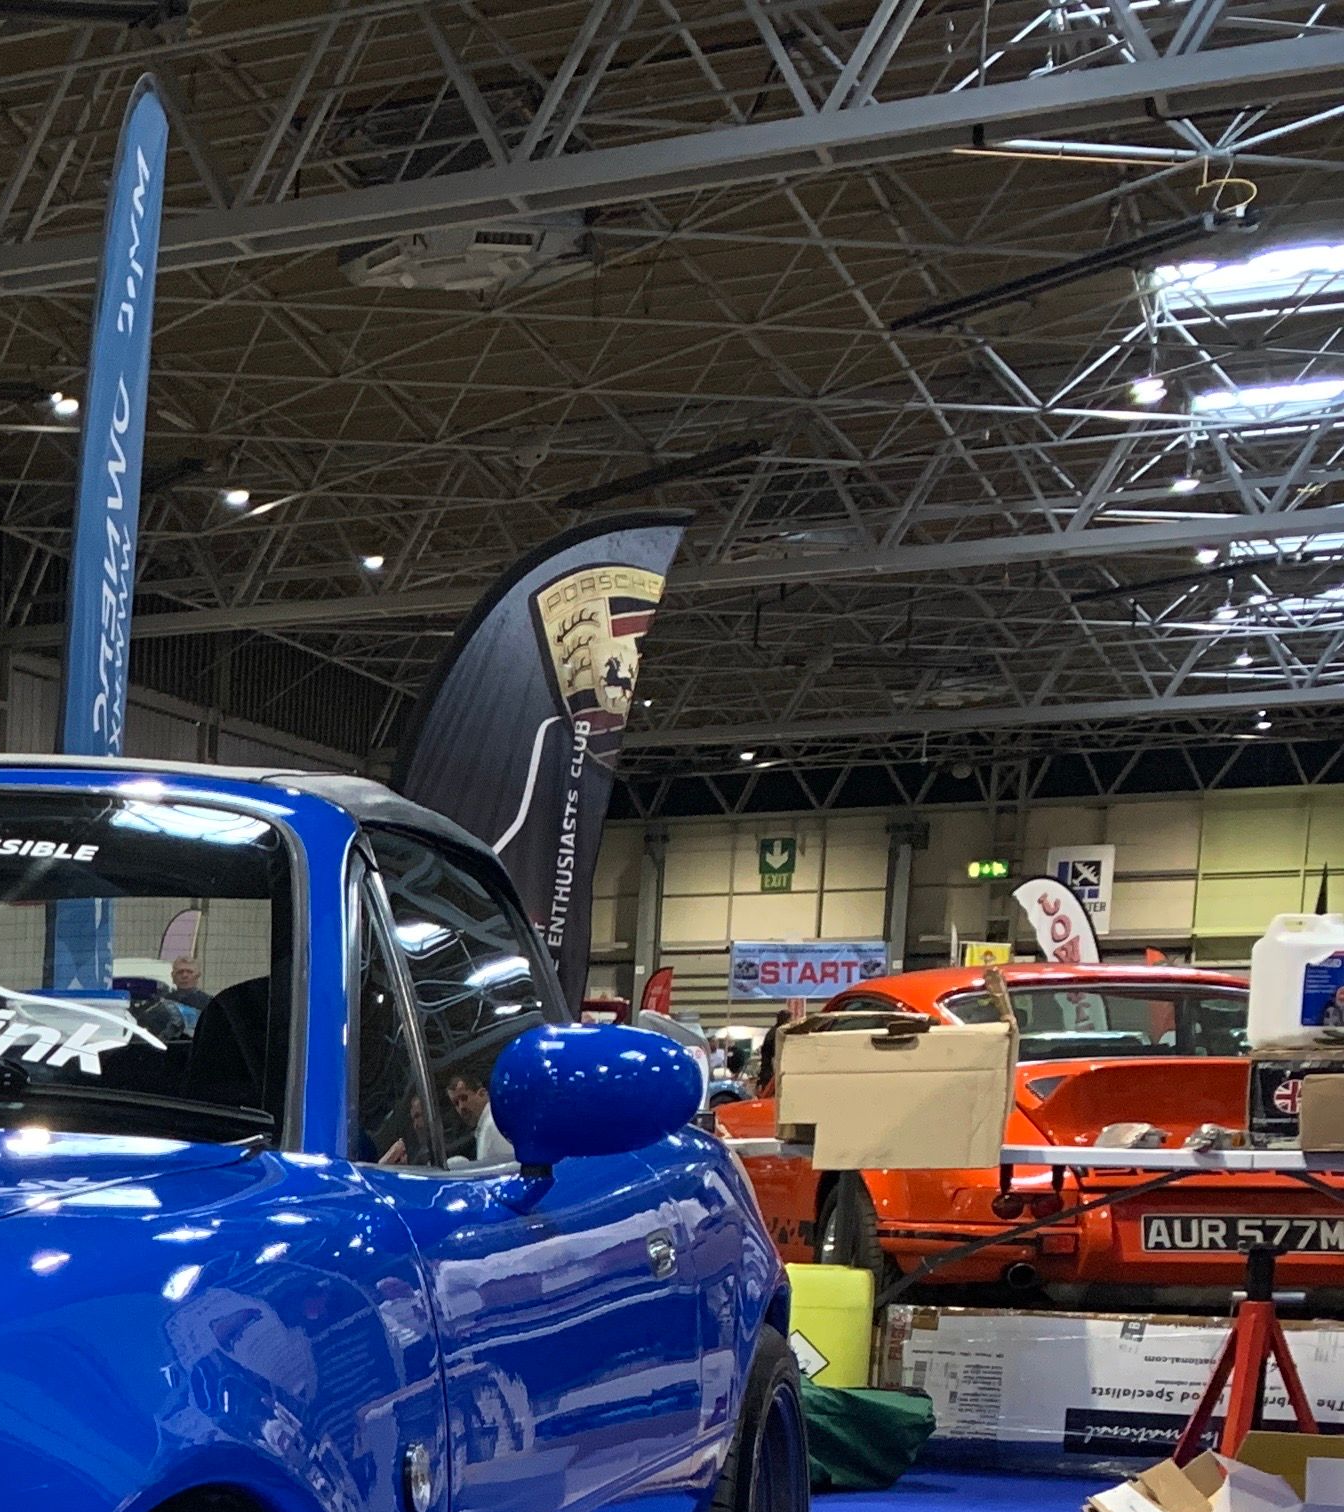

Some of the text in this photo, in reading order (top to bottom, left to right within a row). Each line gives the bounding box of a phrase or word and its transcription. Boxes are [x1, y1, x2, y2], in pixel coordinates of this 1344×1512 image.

[546, 574, 659, 612] PORSCHE
[548, 720, 592, 947] ENTHUSIASTS CLUB
[760, 961, 858, 985] START
[1147, 1218, 1228, 1249] AUR
[1090, 1387, 1175, 1402] Specialists
